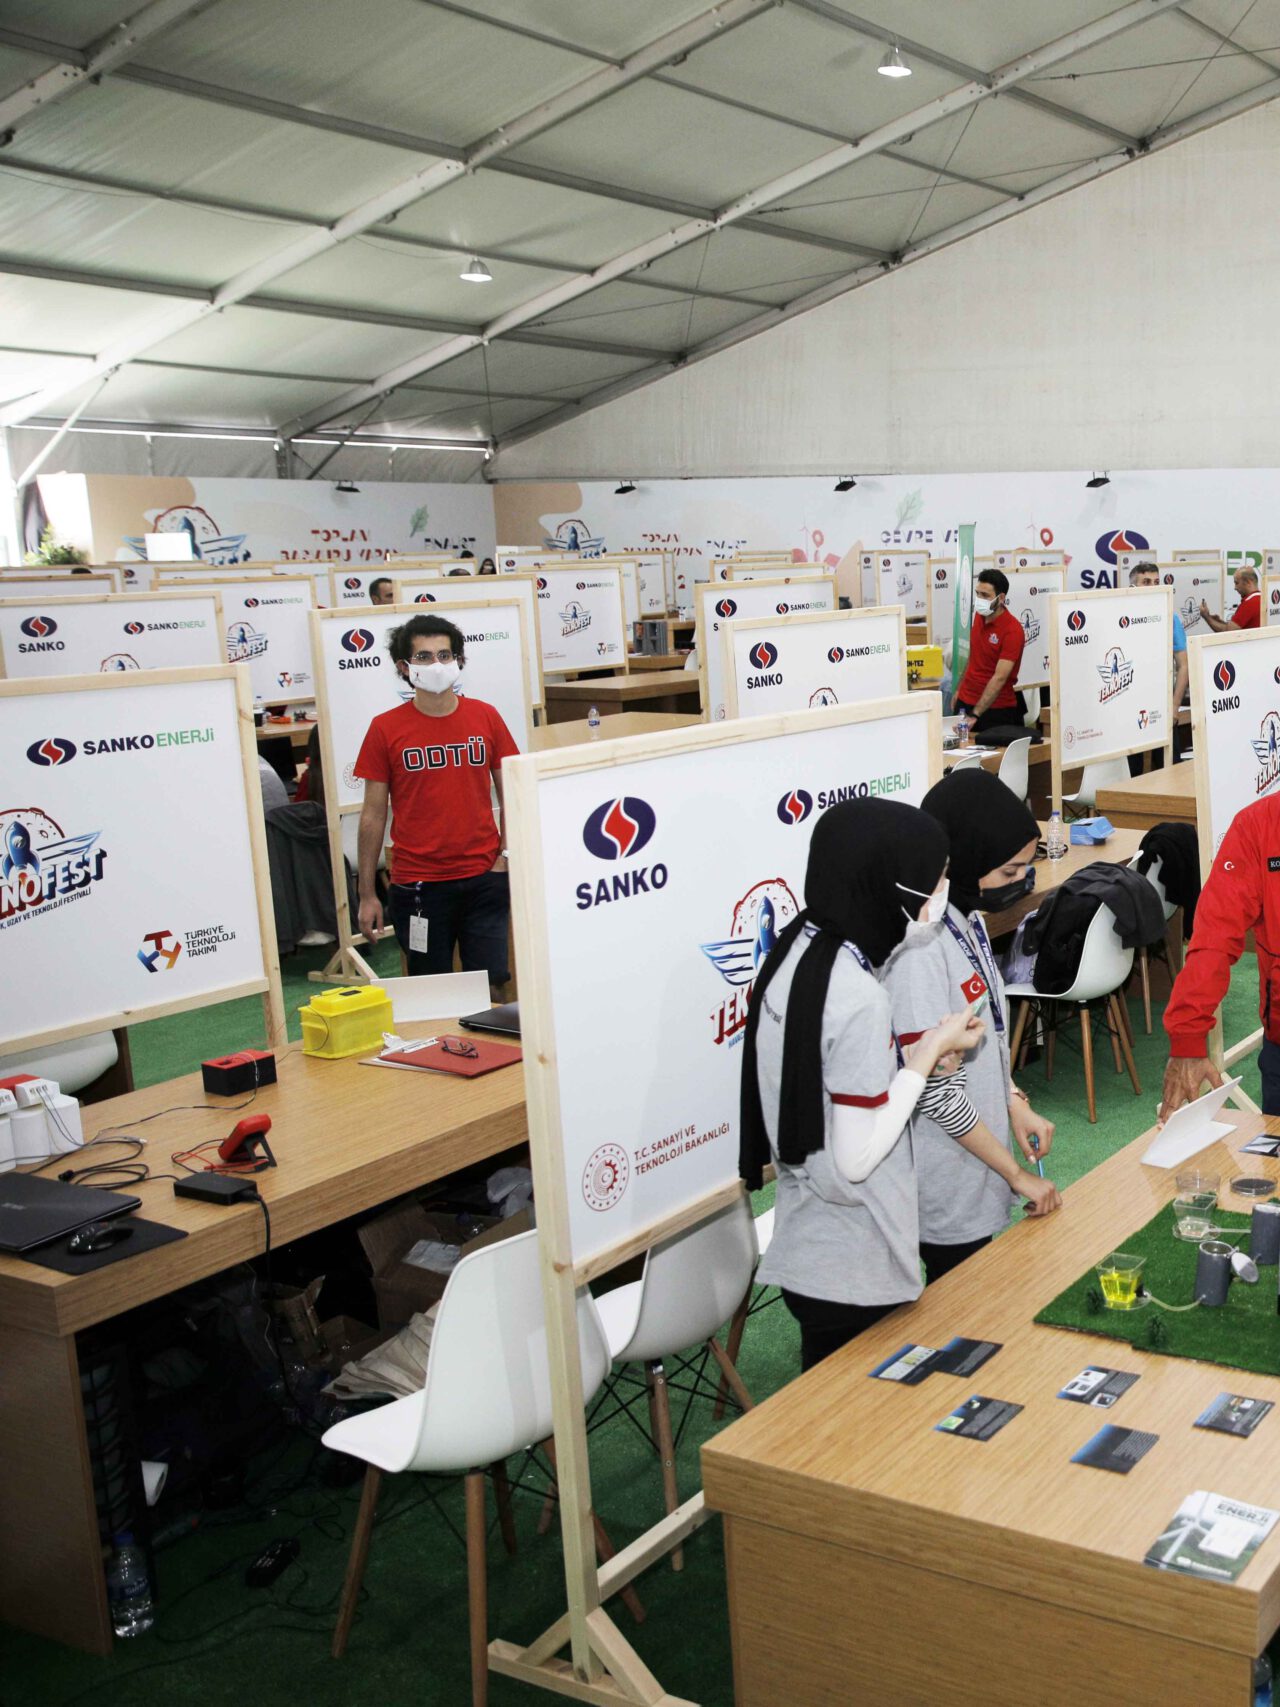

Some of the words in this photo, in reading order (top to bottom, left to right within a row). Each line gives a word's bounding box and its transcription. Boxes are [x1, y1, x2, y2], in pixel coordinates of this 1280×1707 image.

[790, 602, 810, 611] SANKO
[147, 621, 179, 632] SANKO
[1130, 616, 1147, 625] SANKO
[462, 633, 485, 643] ANKO
[1064, 634, 1089, 646] SANKO
[18, 640, 65, 654] SANKO
[845, 646, 870, 658] SANKO
[338, 655, 381, 670] SANKO
[746, 672, 784, 690] SANKO
[1211, 695, 1241, 714] SANKO
[83, 734, 155, 756] SANKO
[402, 736, 487, 772] ODTÜ
[817, 782, 869, 810] SANKO
[576, 862, 669, 911] SANKO
[6, 915, 22, 928] UZAY
[22, 911, 31, 921] VE
[186, 944, 218, 958] TAKIMI
[634, 1147, 650, 1161] T.C.
[651, 1128, 683, 1154] SANAYİ
[684, 1124, 696, 1137] VE
[635, 1143, 683, 1176] TEKNOLOJİ
[685, 1122, 730, 1152] BAKANLIĞI
